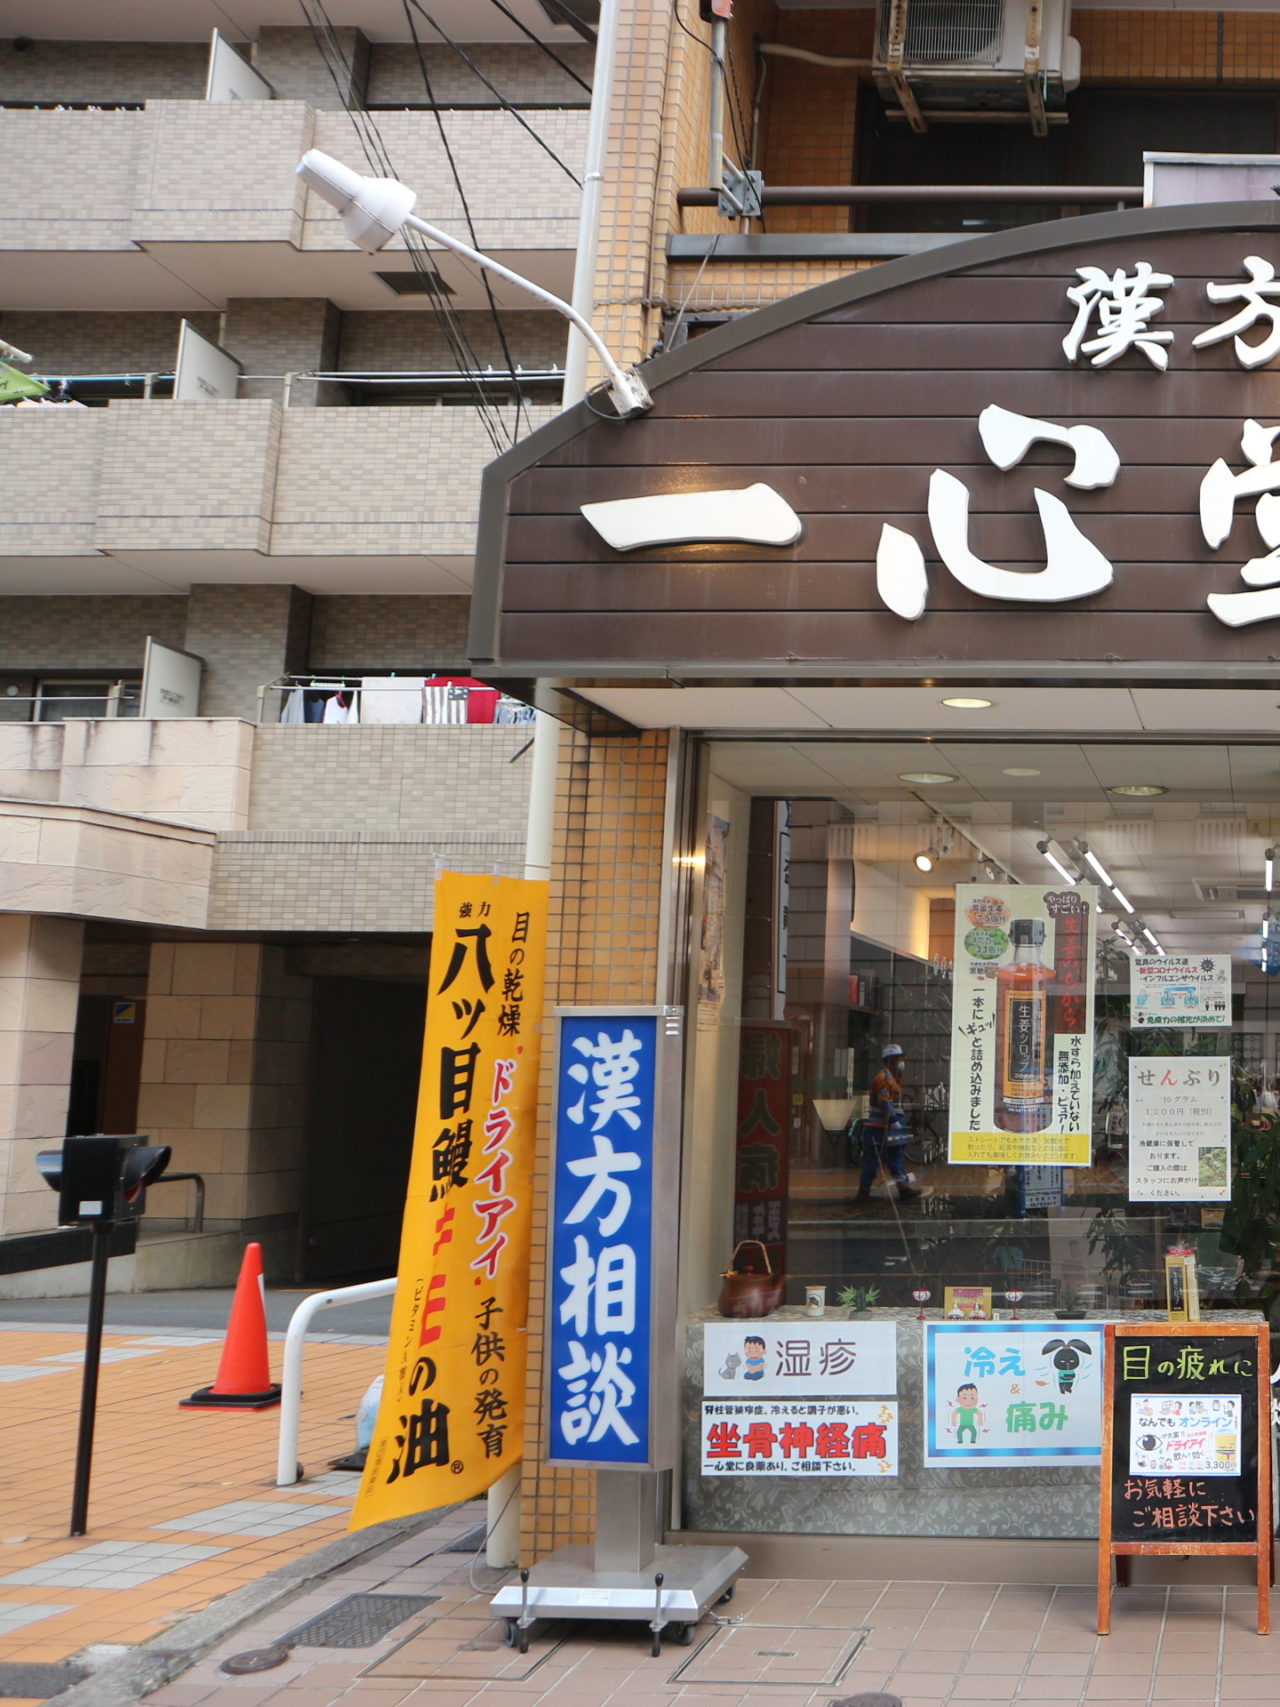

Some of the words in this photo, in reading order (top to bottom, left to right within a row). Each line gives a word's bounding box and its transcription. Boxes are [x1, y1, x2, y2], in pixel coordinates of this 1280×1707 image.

[459, 901, 491, 918] 強力
[1047, 895, 1077, 904] やっぱり
[1137, 1068, 1221, 1087] せんぶり
[558, 1028, 643, 1447] 漢方相談
[774, 1337, 858, 1377] 湿疹
[962, 1344, 1026, 1379] 冷え
[1122, 1344, 1254, 1381] 目の疲れに
[1009, 1383, 1021, 1395] &
[1005, 1400, 1069, 1433] 痛み
[1138, 1416, 1177, 1428] なんでも
[1178, 1416, 1233, 1428] オンライン
[706, 1421, 889, 1460] 坐骨神経痛
[1123, 1478, 1207, 1500] お気軽に
[1132, 1502, 1255, 1529] ご相談下さい
